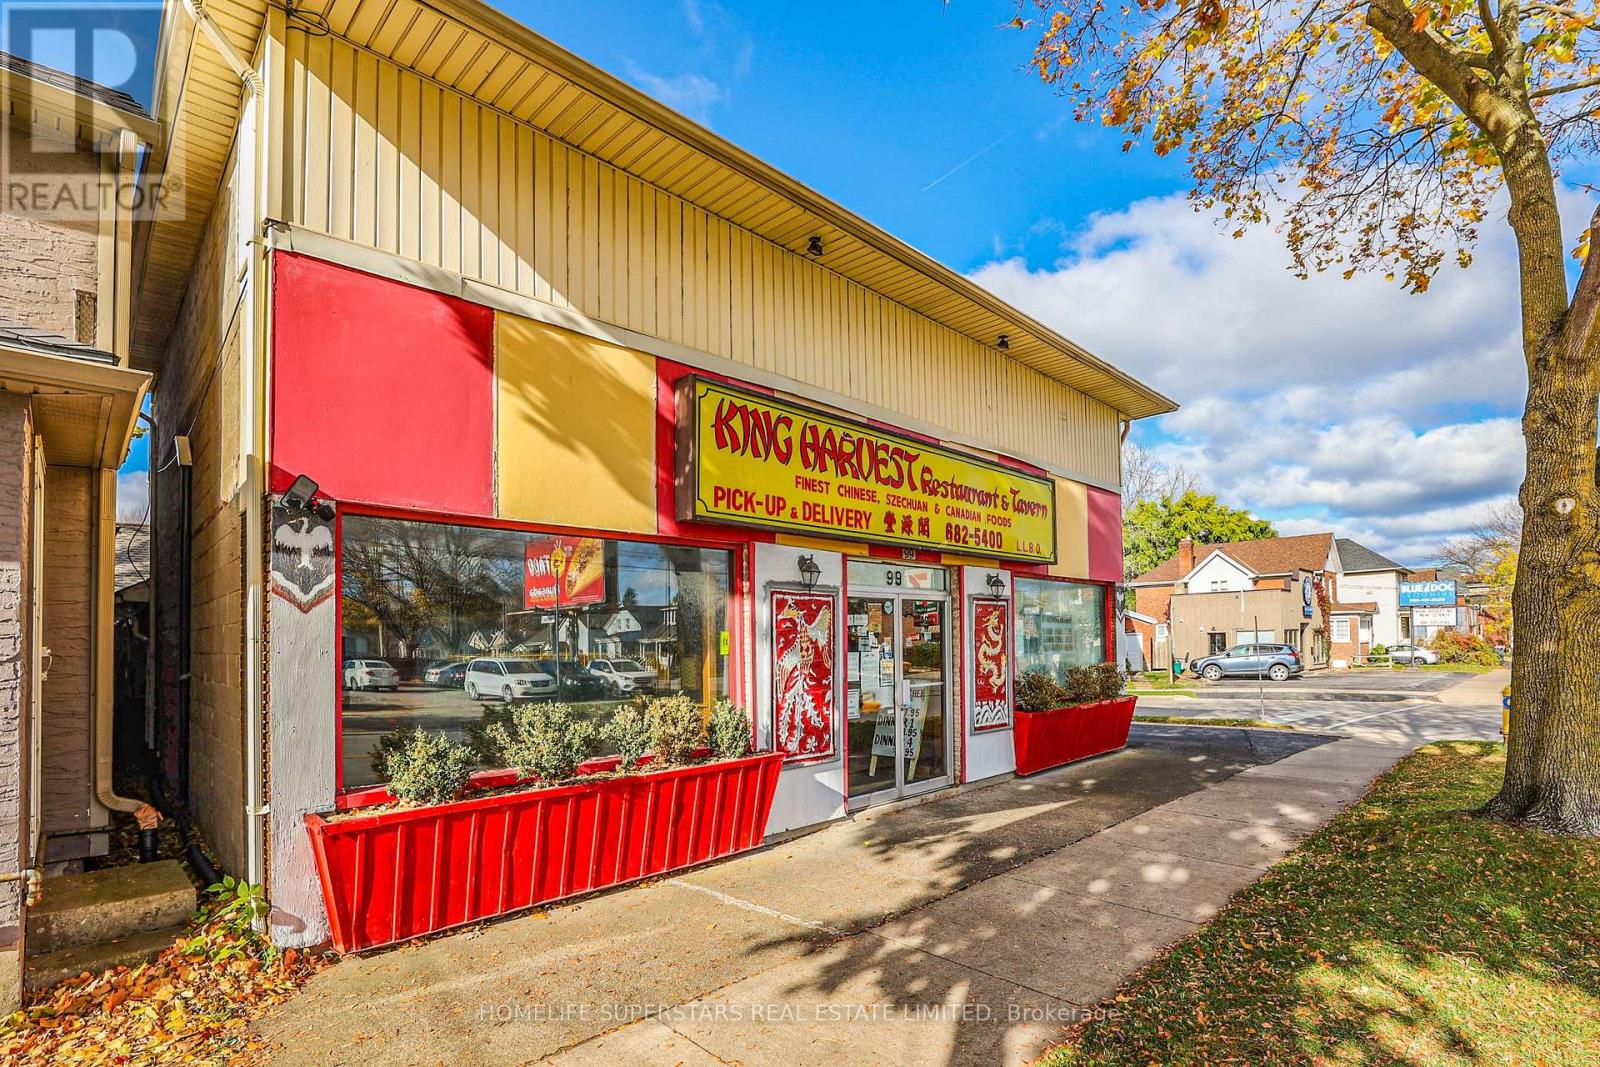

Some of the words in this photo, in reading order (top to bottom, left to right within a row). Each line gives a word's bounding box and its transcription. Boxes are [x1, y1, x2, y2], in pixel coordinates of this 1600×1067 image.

[711, 398, 793, 466] KING
[800, 420, 919, 492] HARVEST
[920, 464, 999, 510] Restaurant
[1001, 495, 1010, 512] &
[1010, 487, 1048, 520] Tavern
[713, 485, 787, 517] PICK-UP
[790, 507, 798, 520] &
[802, 501, 873, 530] DELIVERY
[795, 475, 831, 495] FINEST
[886, 494, 928, 513] SZECHUAN
[934, 503, 941, 515] &
[946, 505, 982, 522] CANADIAN
[987, 514, 1012, 528] FOODS
[903, 549, 914, 559] 99
[945, 522, 1003, 550] 682-5400
[886, 570, 902, 586] 99
